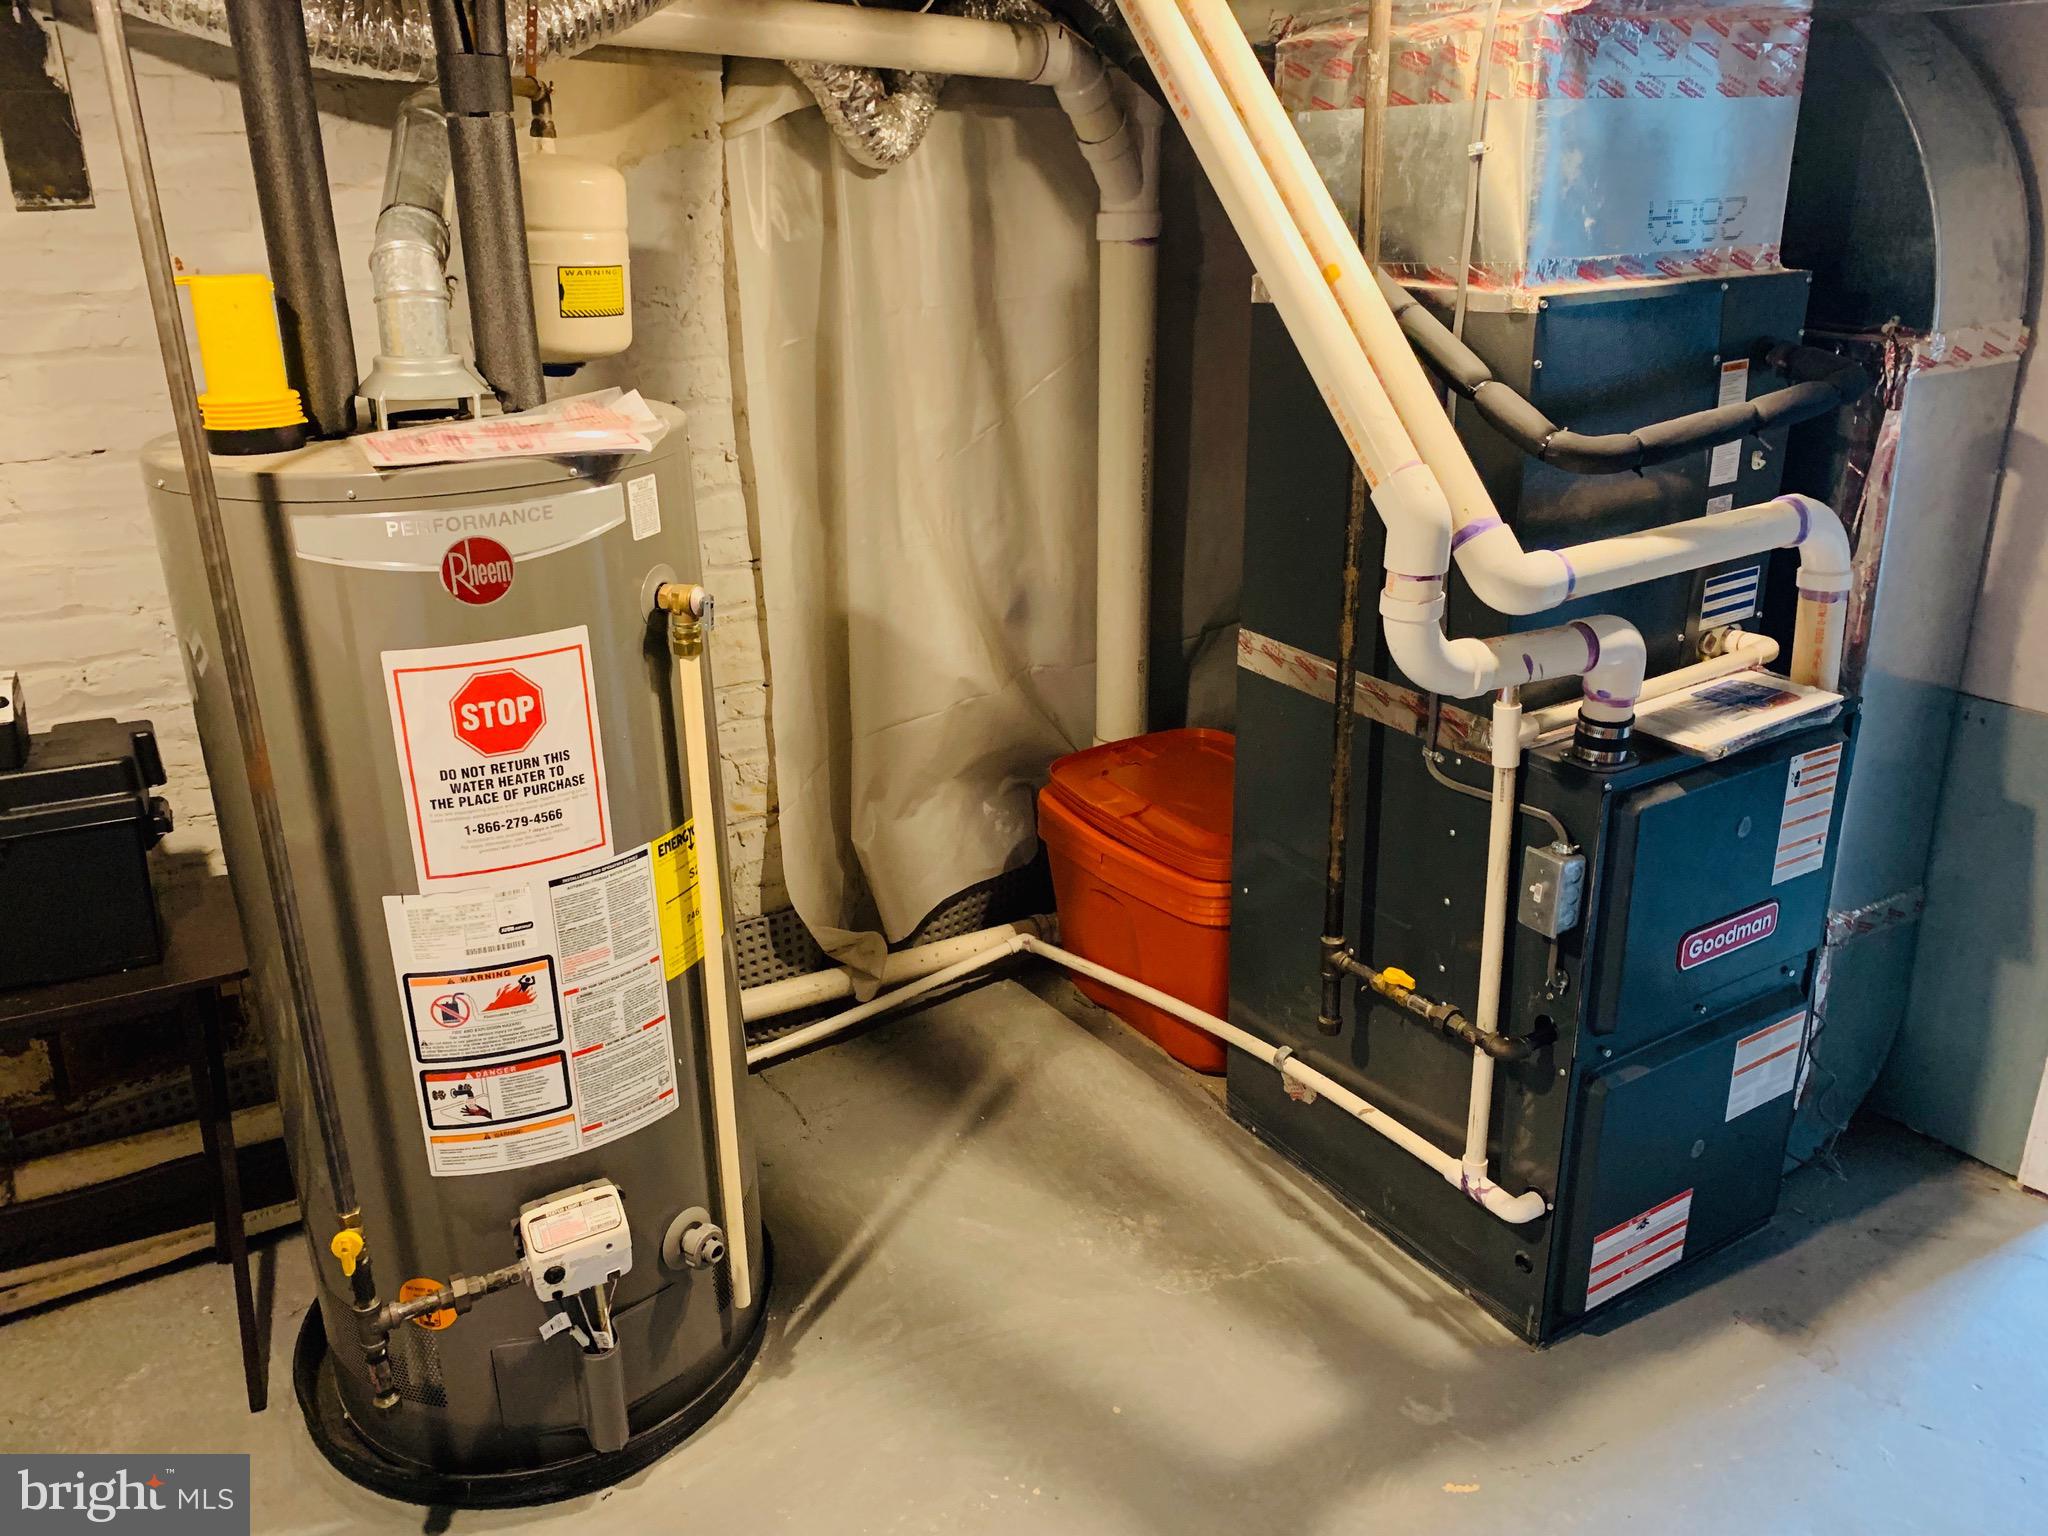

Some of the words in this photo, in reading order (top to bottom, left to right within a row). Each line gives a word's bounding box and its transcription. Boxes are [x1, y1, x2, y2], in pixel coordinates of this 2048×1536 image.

[386, 505, 554, 538] PERFORMANCE
[448, 539, 512, 596] Rheem
[460, 695, 535, 732] STOP
[439, 769, 457, 781] DO
[461, 766, 486, 779] NOT
[491, 757, 540, 775] RETURN
[544, 750, 571, 765] THIS
[450, 778, 494, 794] WATER
[498, 770, 546, 788] HEATER
[549, 765, 565, 778] TO
[430, 797, 454, 810] THE
[459, 792, 500, 808] PLACE
[503, 789, 519, 801] OF
[524, 774, 586, 798] PURCHASE
[464, 809, 563, 836] 1-866-279-4566
[1689, 914, 1772, 959] Goodman
[460, 969, 512, 983] WARNING
[475, 1066, 517, 1079] DANGER
